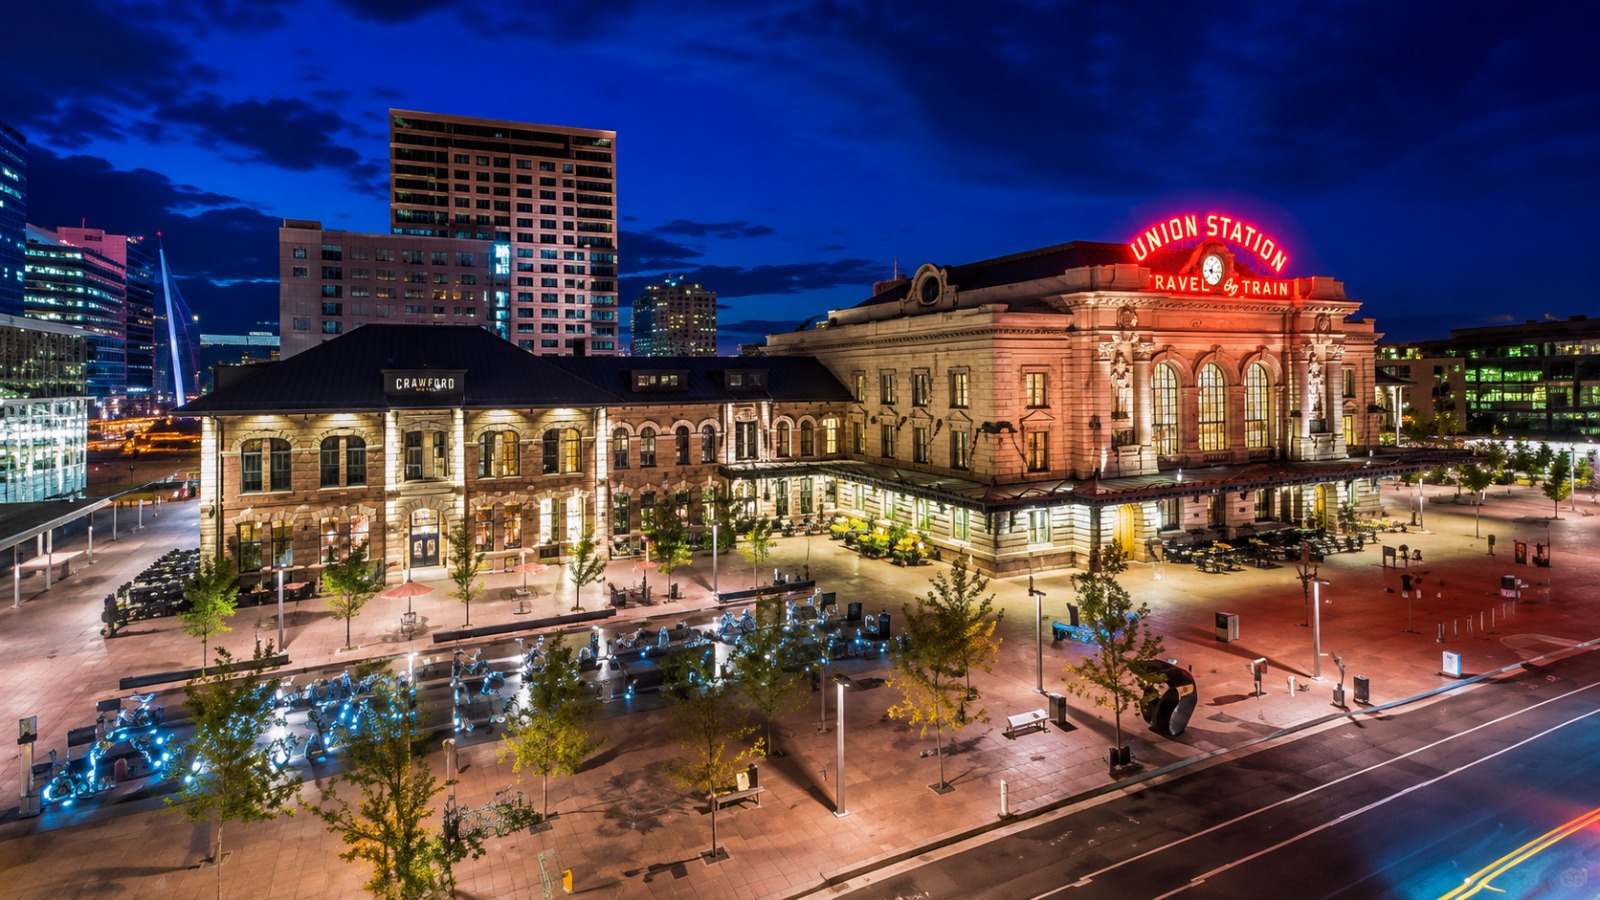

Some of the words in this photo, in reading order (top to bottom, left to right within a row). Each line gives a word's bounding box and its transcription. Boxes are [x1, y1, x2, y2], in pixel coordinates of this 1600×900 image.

[1131, 215, 1197, 261] UNION
[1207, 215, 1287, 272] STATION
[1149, 275, 1210, 292] RAVEL
[1242, 280, 1288, 296] TRAIN
[396, 378, 454, 390] CRAWFORD
